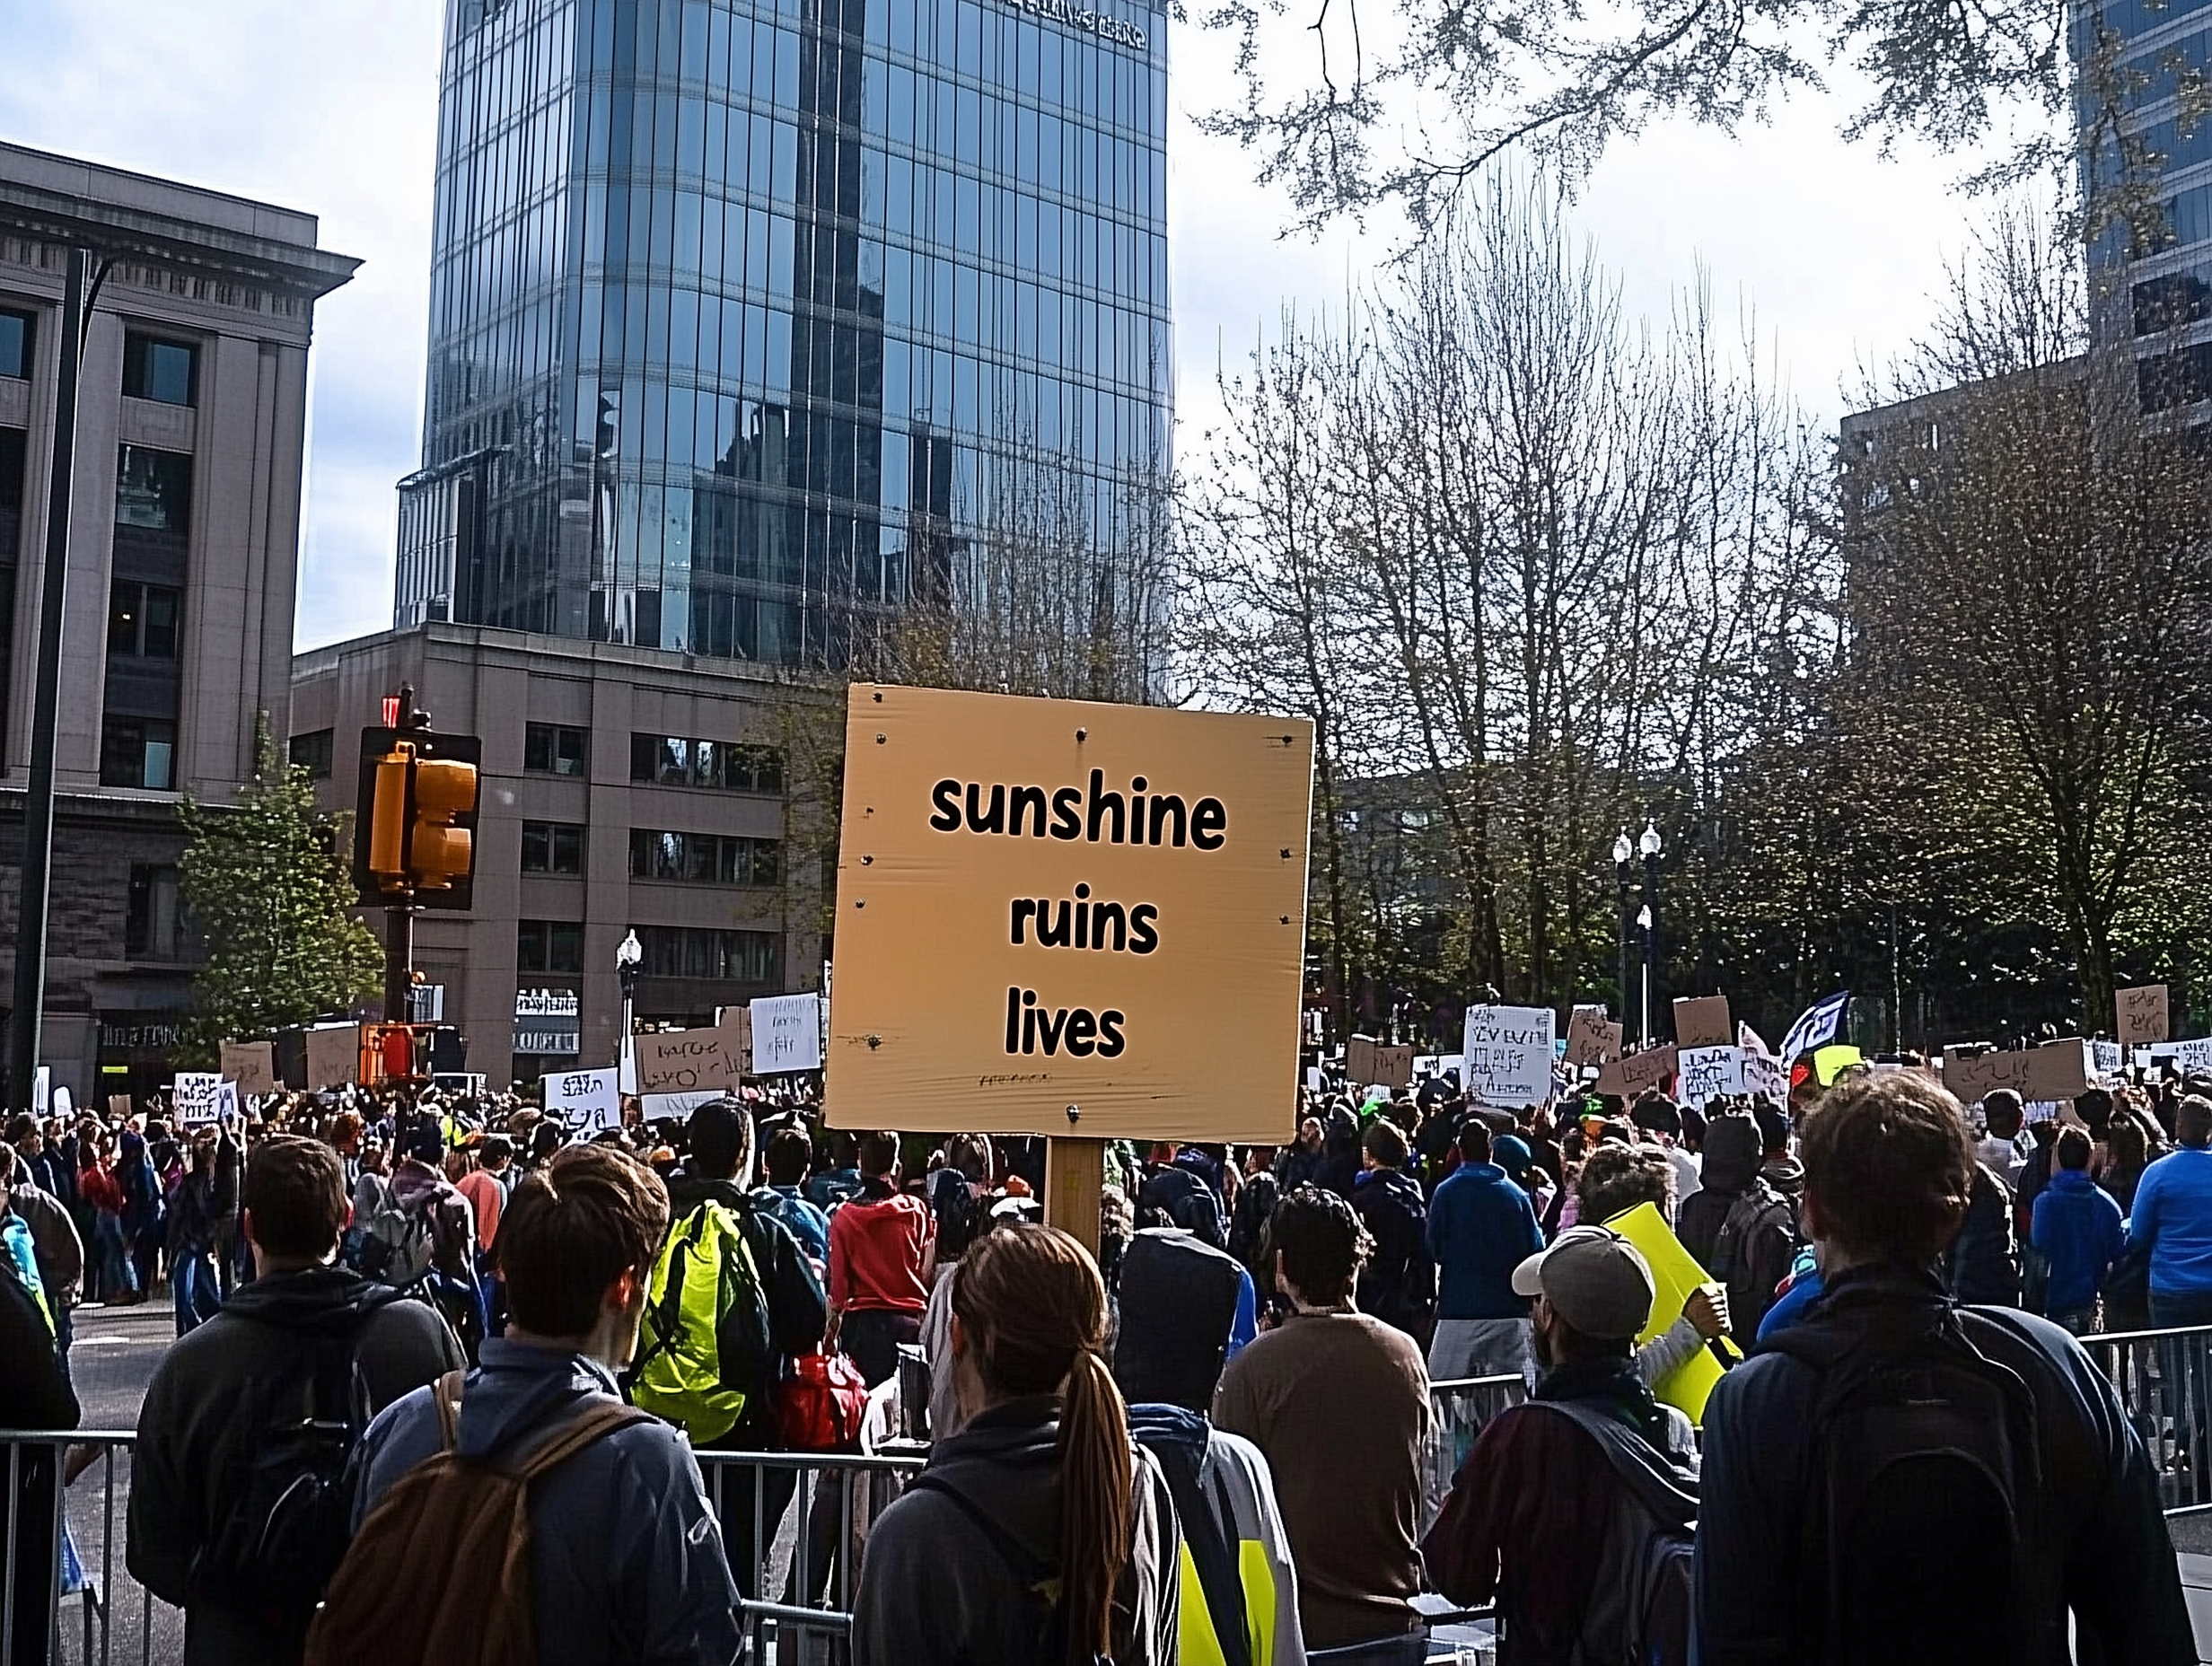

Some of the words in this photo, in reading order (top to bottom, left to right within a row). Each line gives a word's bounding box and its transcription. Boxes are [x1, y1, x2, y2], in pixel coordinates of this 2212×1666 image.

[930, 768, 1226, 851] sunshine
[1011, 882, 1158, 954] ruins
[1005, 986, 1125, 1057] lives
